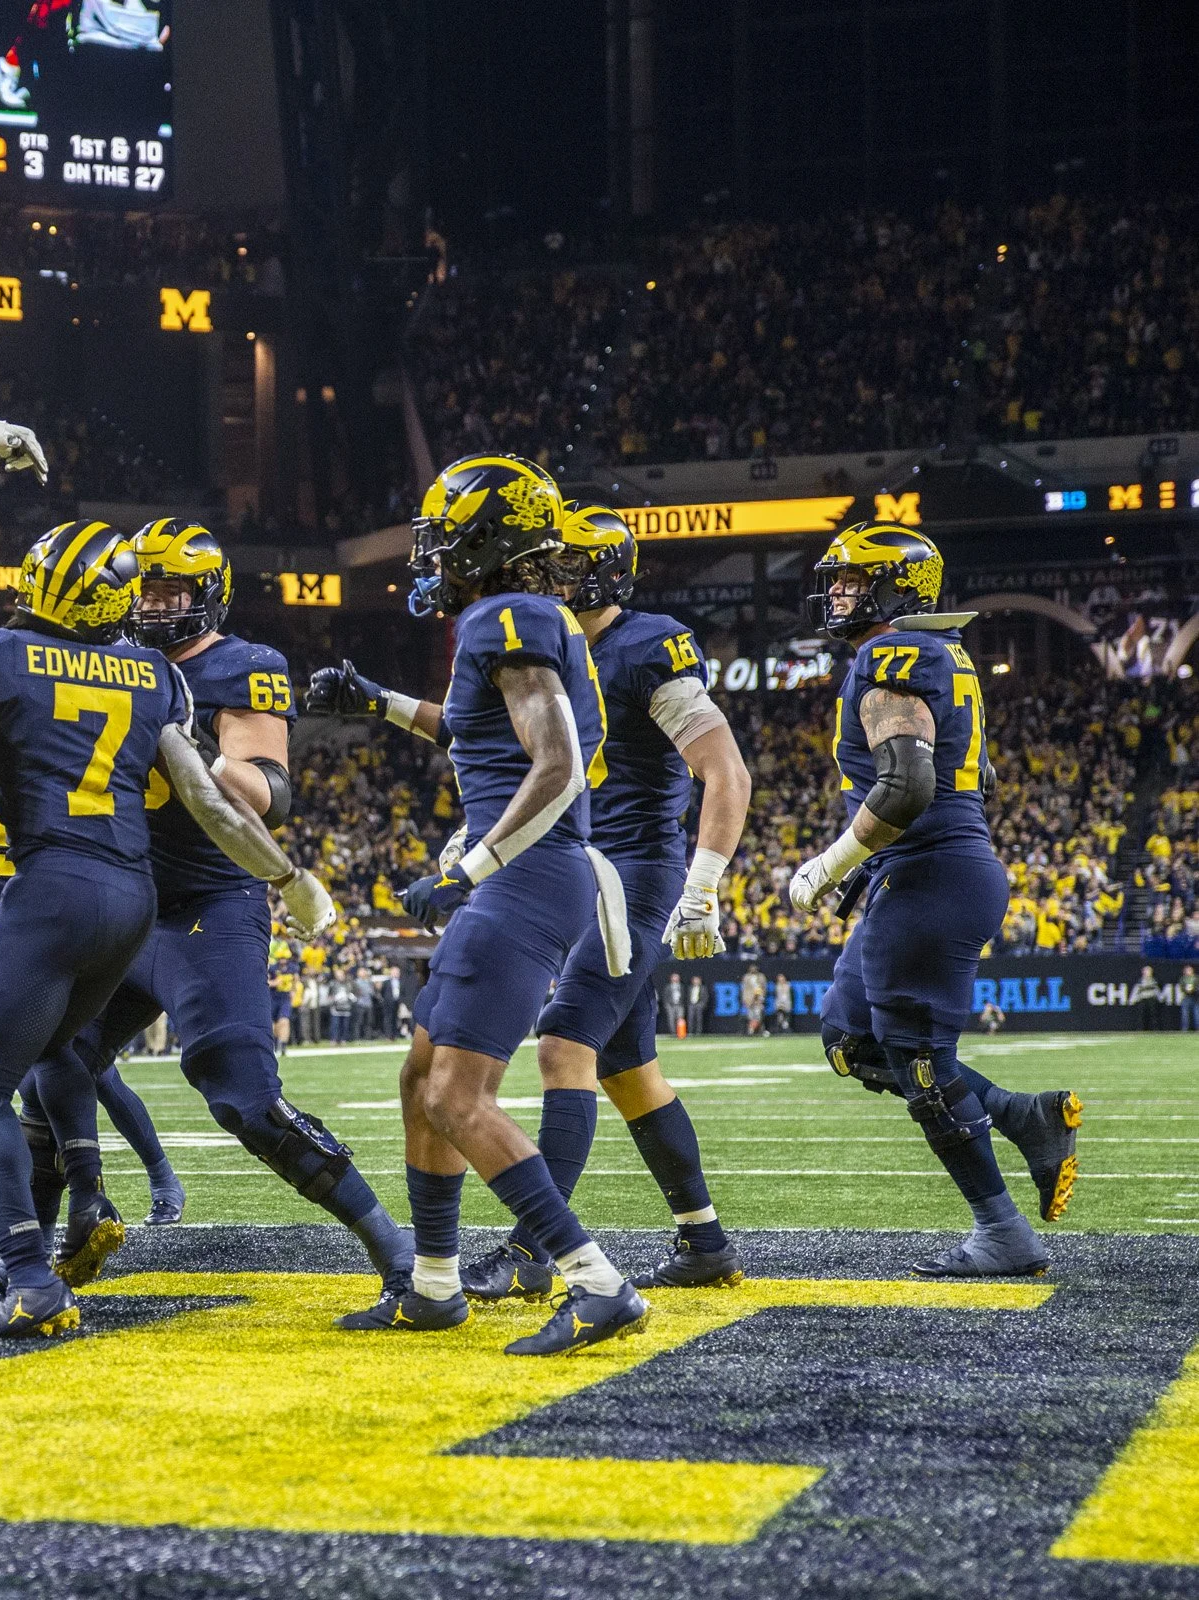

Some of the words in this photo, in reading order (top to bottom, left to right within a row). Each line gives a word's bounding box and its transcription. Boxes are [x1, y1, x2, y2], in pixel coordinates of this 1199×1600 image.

[19, 132, 49, 150] QTR
[70, 135, 106, 160] 1ST
[111, 137, 131, 162] &
[136, 140, 164, 164] 10
[24, 150, 45, 179] 3
[63, 162, 90, 184] ON
[93, 164, 130, 187] THE
[135, 166, 165, 191] 27
[160, 288, 213, 332] M
[875, 492, 922, 525] M
[498, 608, 523, 651] 1
[26, 644, 157, 689] EDWARDS
[872, 646, 920, 682] 77
[248, 672, 292, 712] 65
[53, 681, 133, 816] 7
